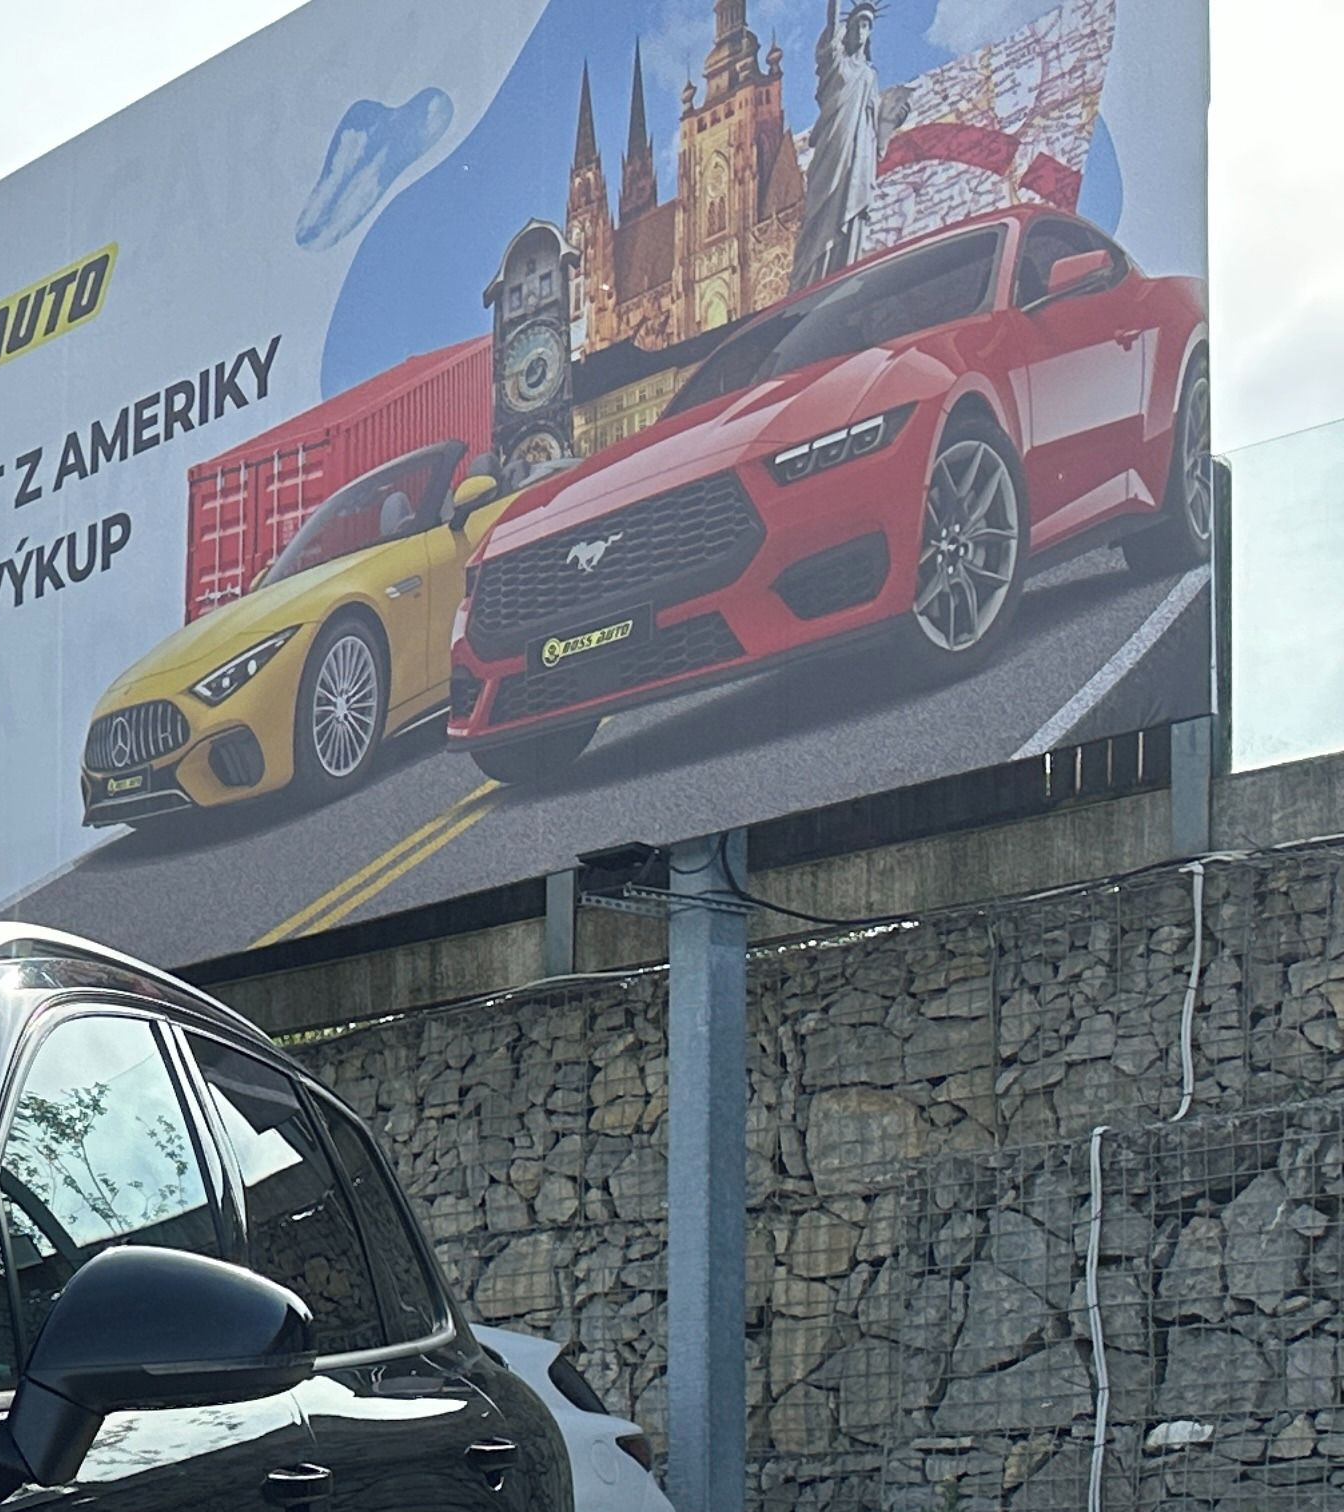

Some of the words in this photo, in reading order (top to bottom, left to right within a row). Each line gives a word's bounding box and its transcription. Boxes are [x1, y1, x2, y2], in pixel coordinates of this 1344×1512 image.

[14, 446, 43, 510] Z
[52, 334, 283, 493] AMERIKY
[562, 635, 593, 654] BOSS
[596, 623, 630, 644] AUTO
